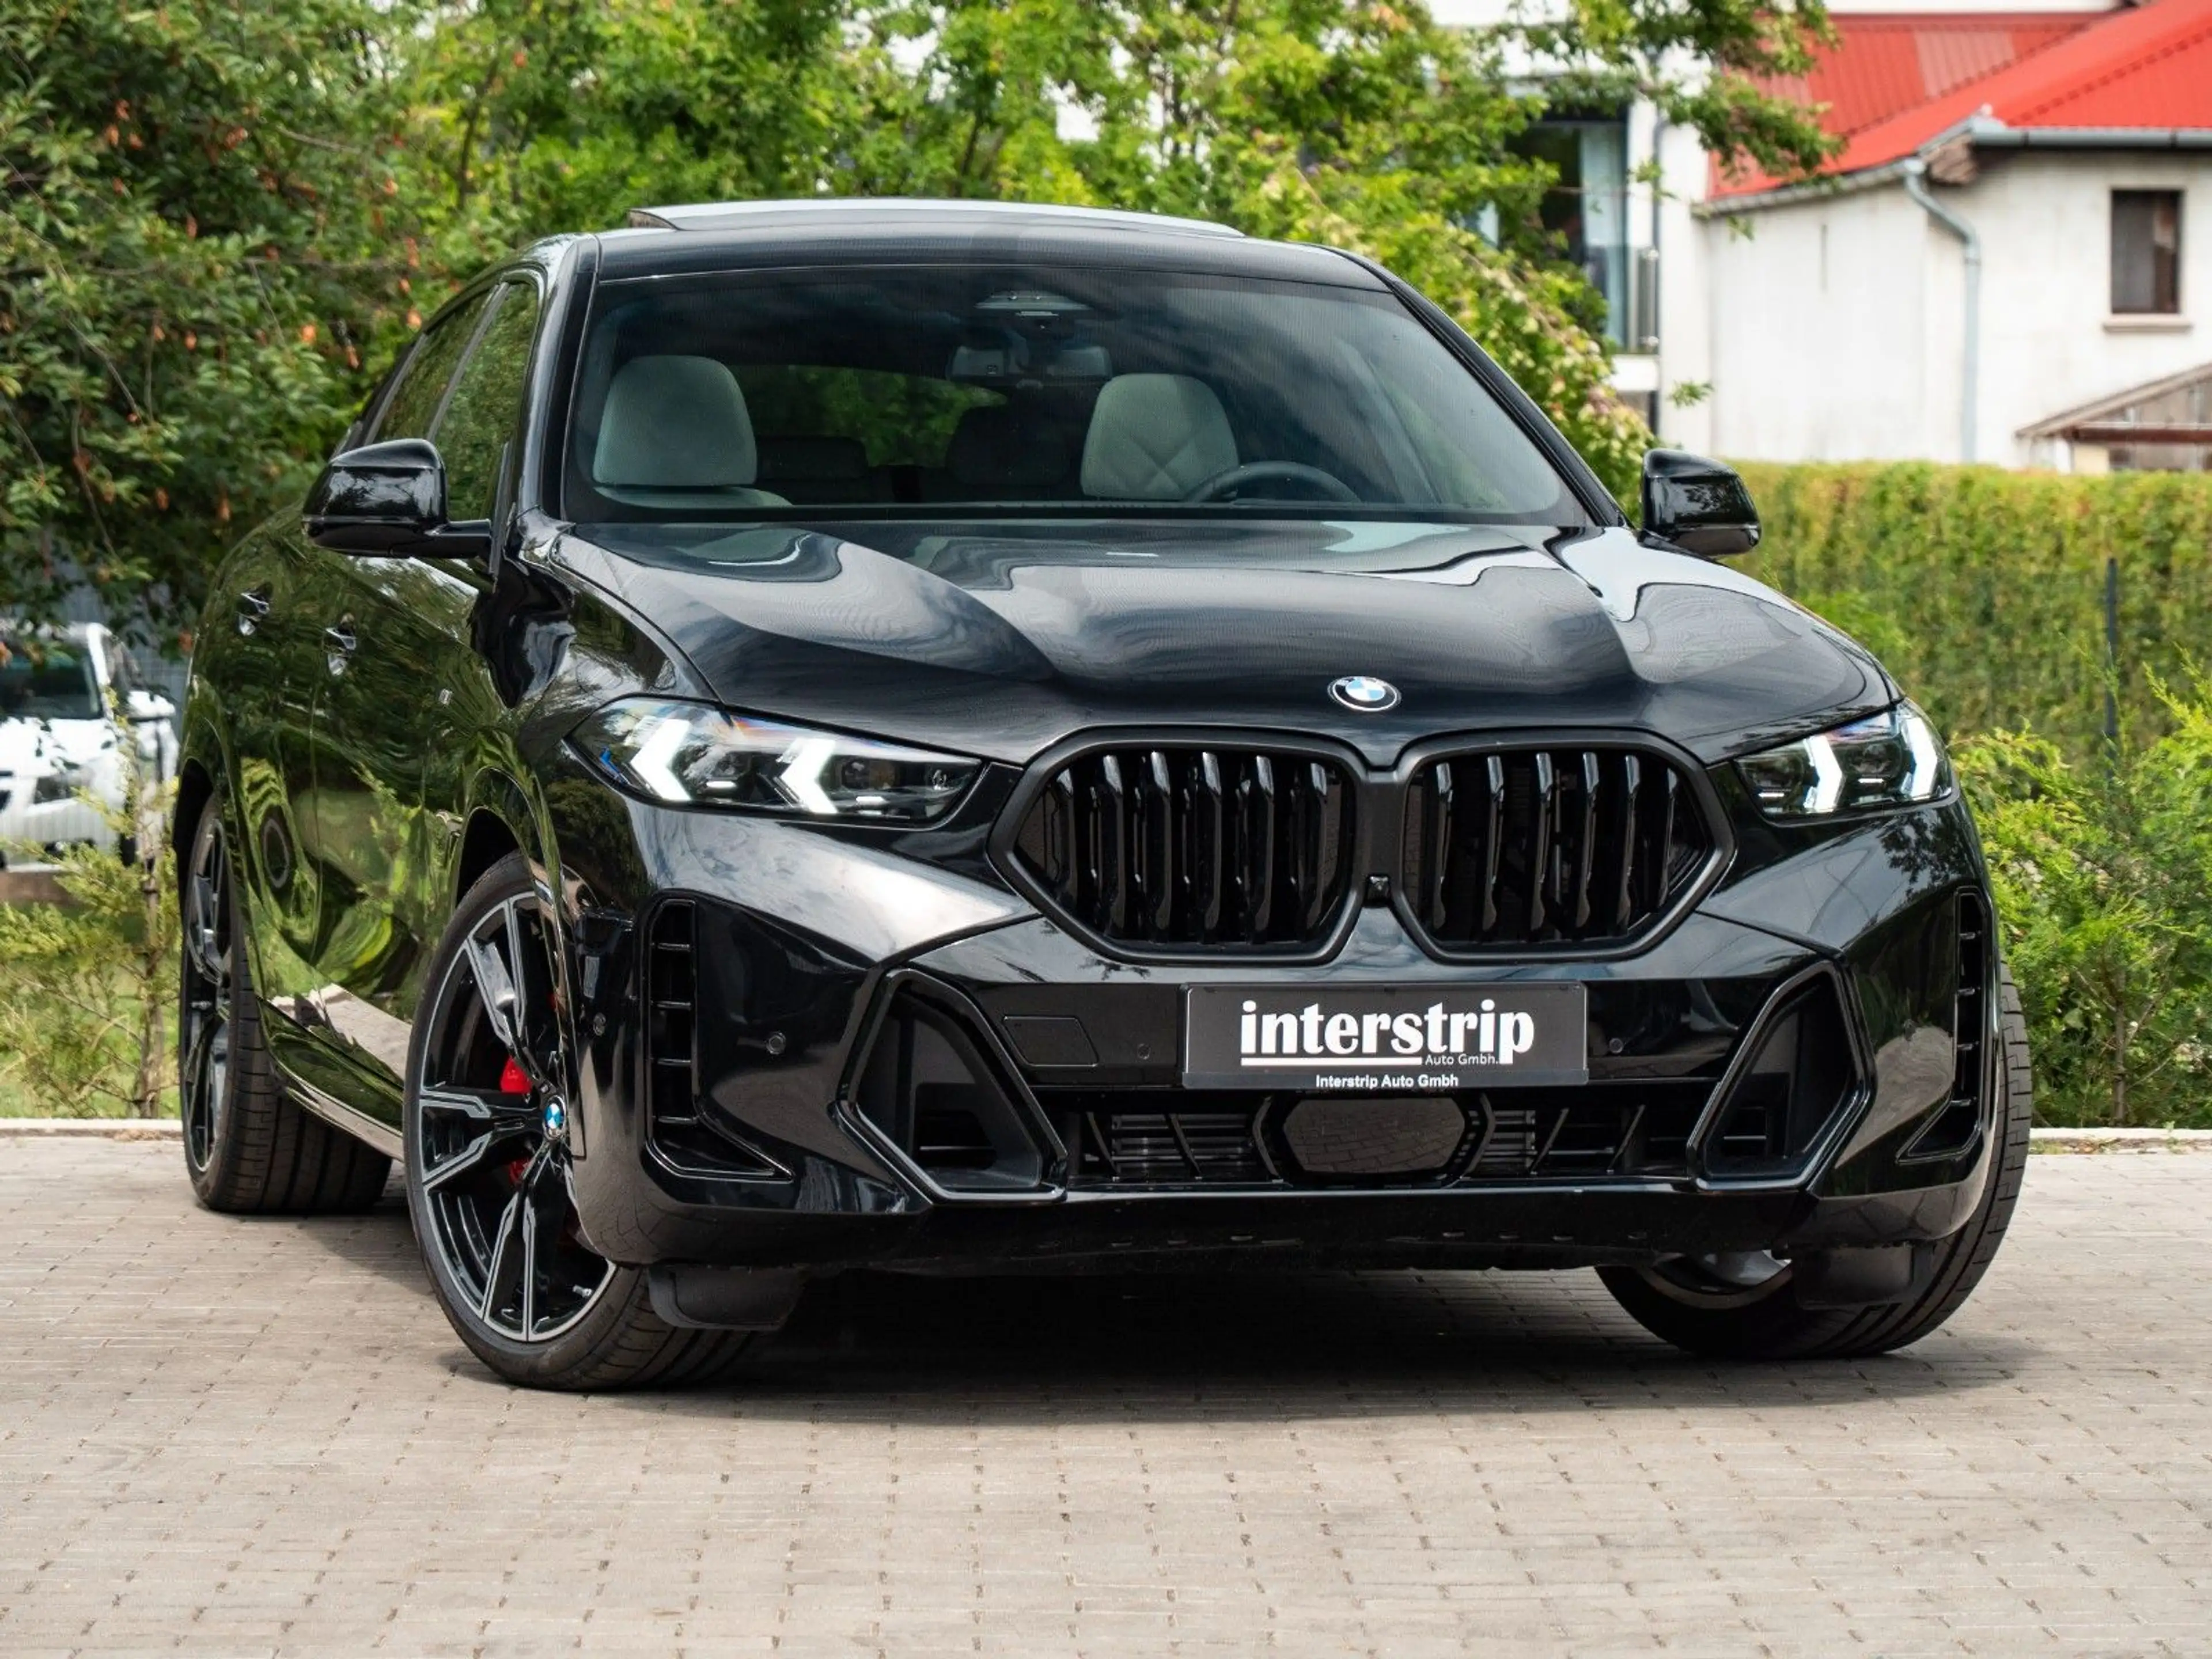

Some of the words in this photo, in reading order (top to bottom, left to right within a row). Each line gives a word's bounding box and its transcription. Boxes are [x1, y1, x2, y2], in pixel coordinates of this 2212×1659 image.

[1240, 999, 1535, 1065] interstrip
[1425, 1054, 1455, 1065] Auto
[1316, 1074, 1378, 1089] Interstrip
[1381, 1074, 1414, 1088] Auto
[1418, 1073, 1459, 1088] Gmbh
